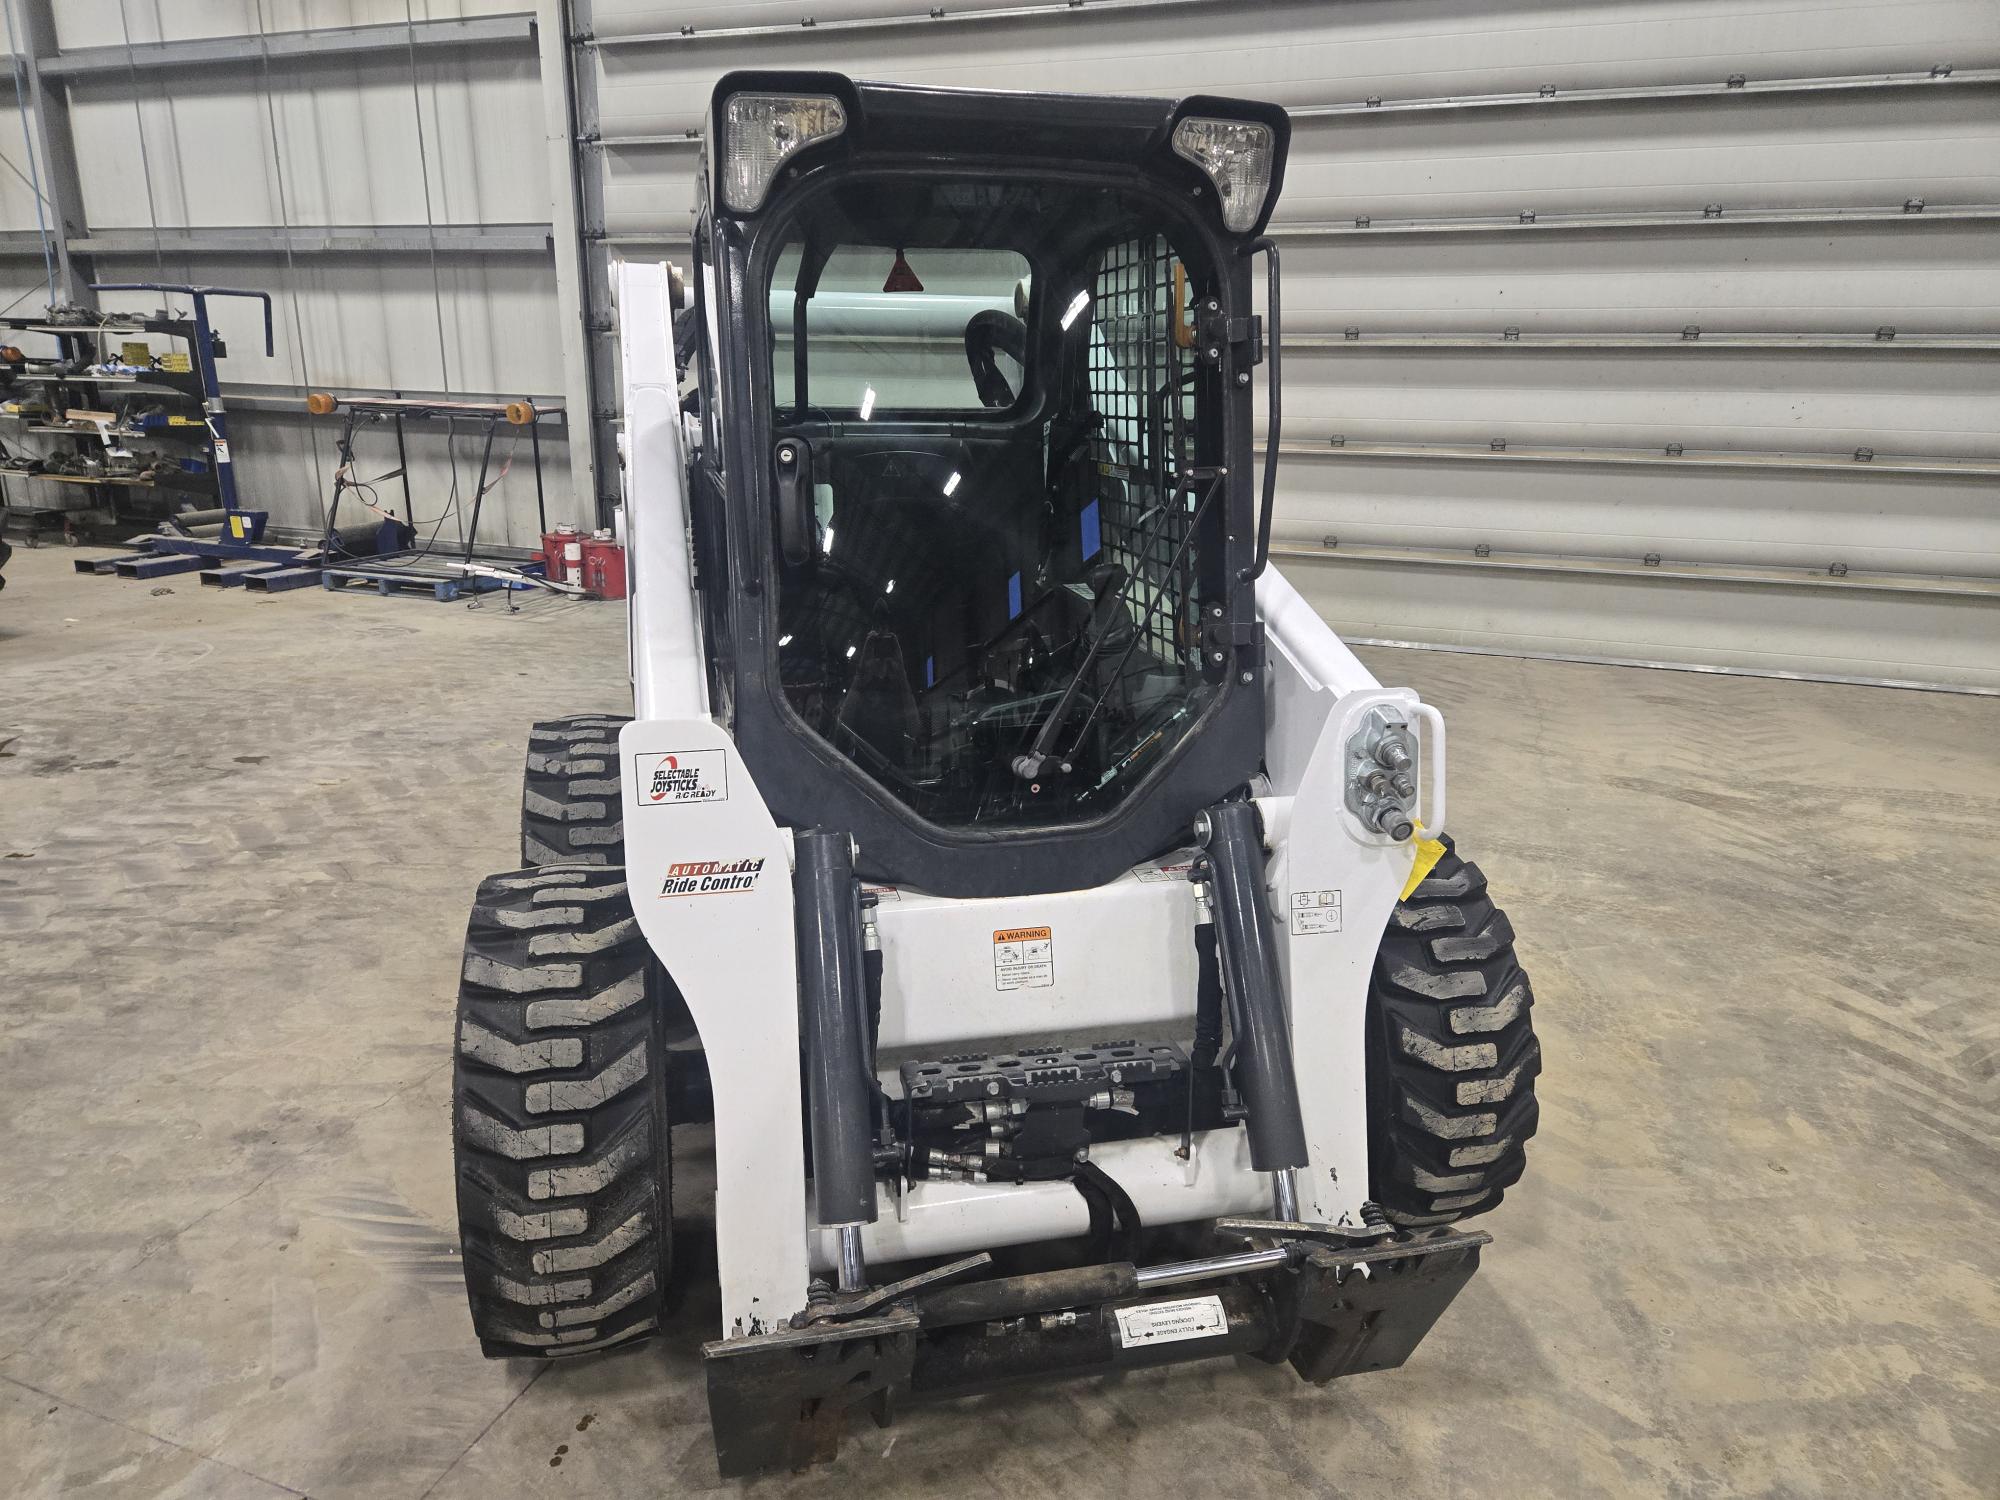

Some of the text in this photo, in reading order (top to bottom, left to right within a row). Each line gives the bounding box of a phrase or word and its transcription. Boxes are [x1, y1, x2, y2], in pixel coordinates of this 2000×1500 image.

[653, 768, 700, 781] SELECTABLE
[650, 779, 698, 793] JOYSTICKS
[671, 860, 760, 876] AUTOMATIC
[662, 877, 698, 894] Ride
[1006, 929, 1047, 940] WARNING
[1171, 1316, 1195, 1325] LOCKING
